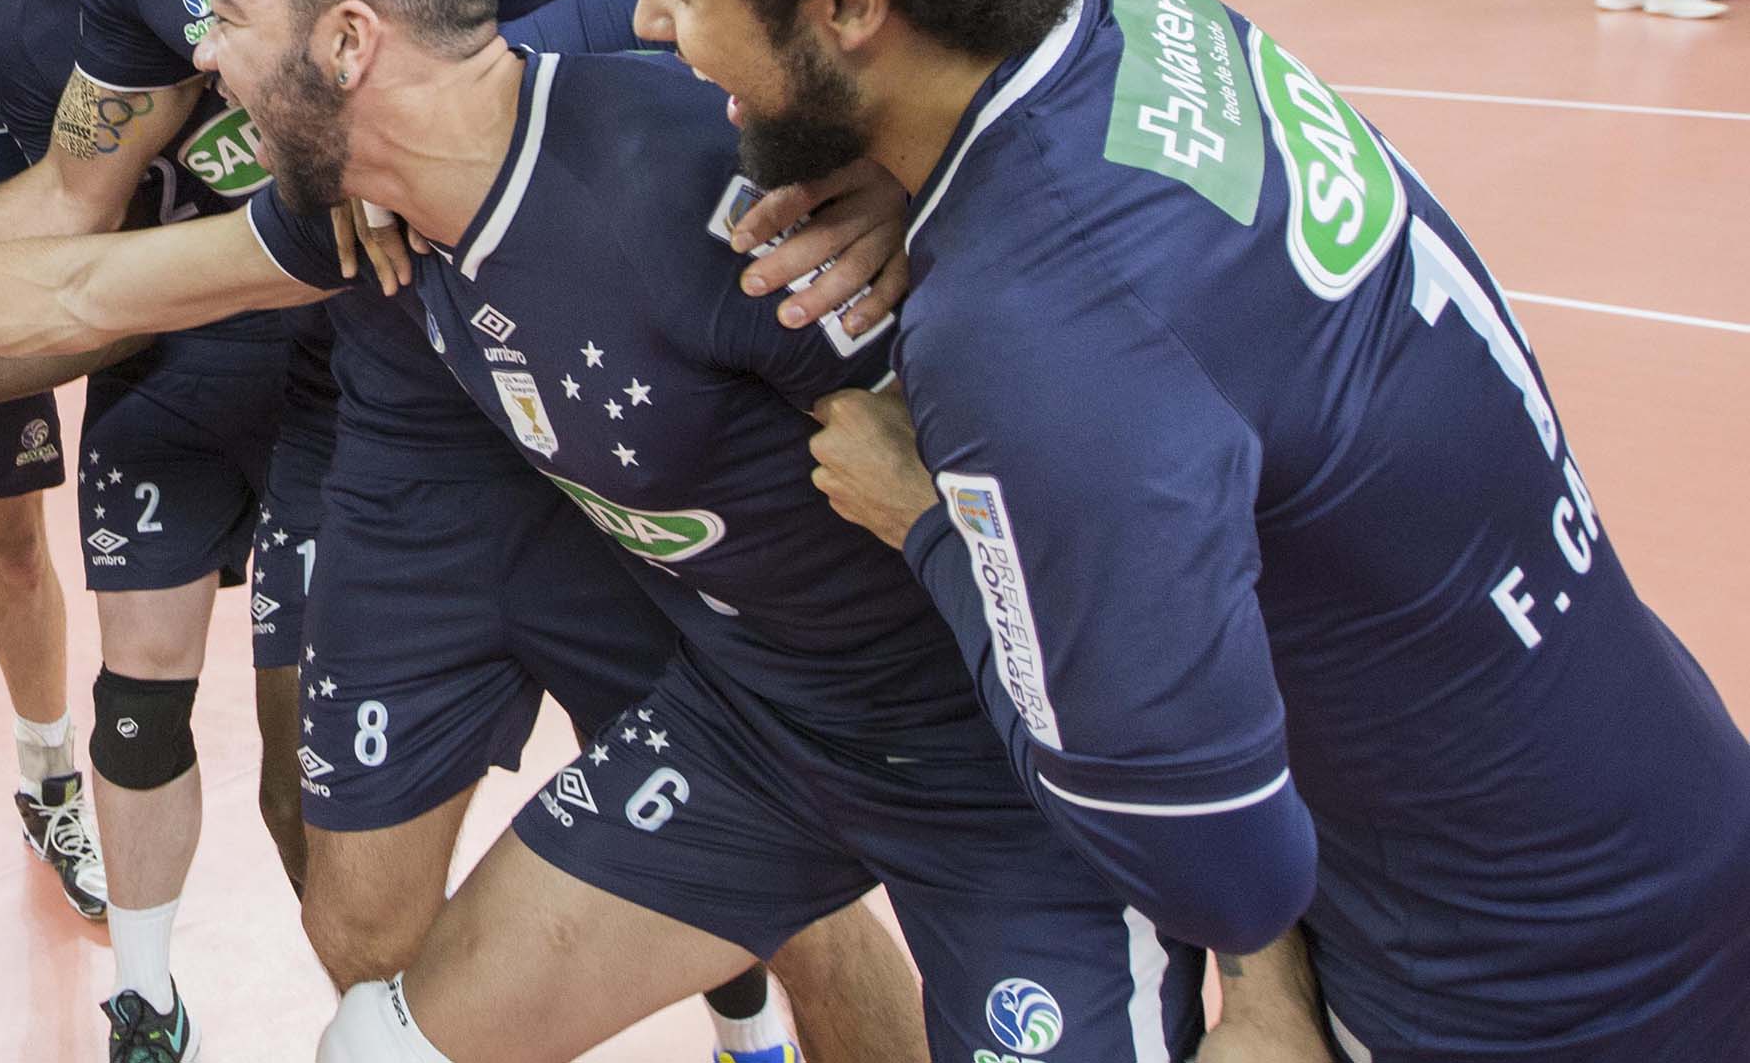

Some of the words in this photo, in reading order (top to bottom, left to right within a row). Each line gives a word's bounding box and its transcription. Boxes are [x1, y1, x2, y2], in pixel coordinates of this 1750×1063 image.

[483, 344, 527, 366] umbro
[135, 482, 163, 533] 2
[92, 553, 127, 566] umbro
[988, 544, 1048, 732] PREFEITURA
[1489, 566, 1571, 649] F.
[354, 700, 389, 767] 8
[625, 767, 690, 833] 6
